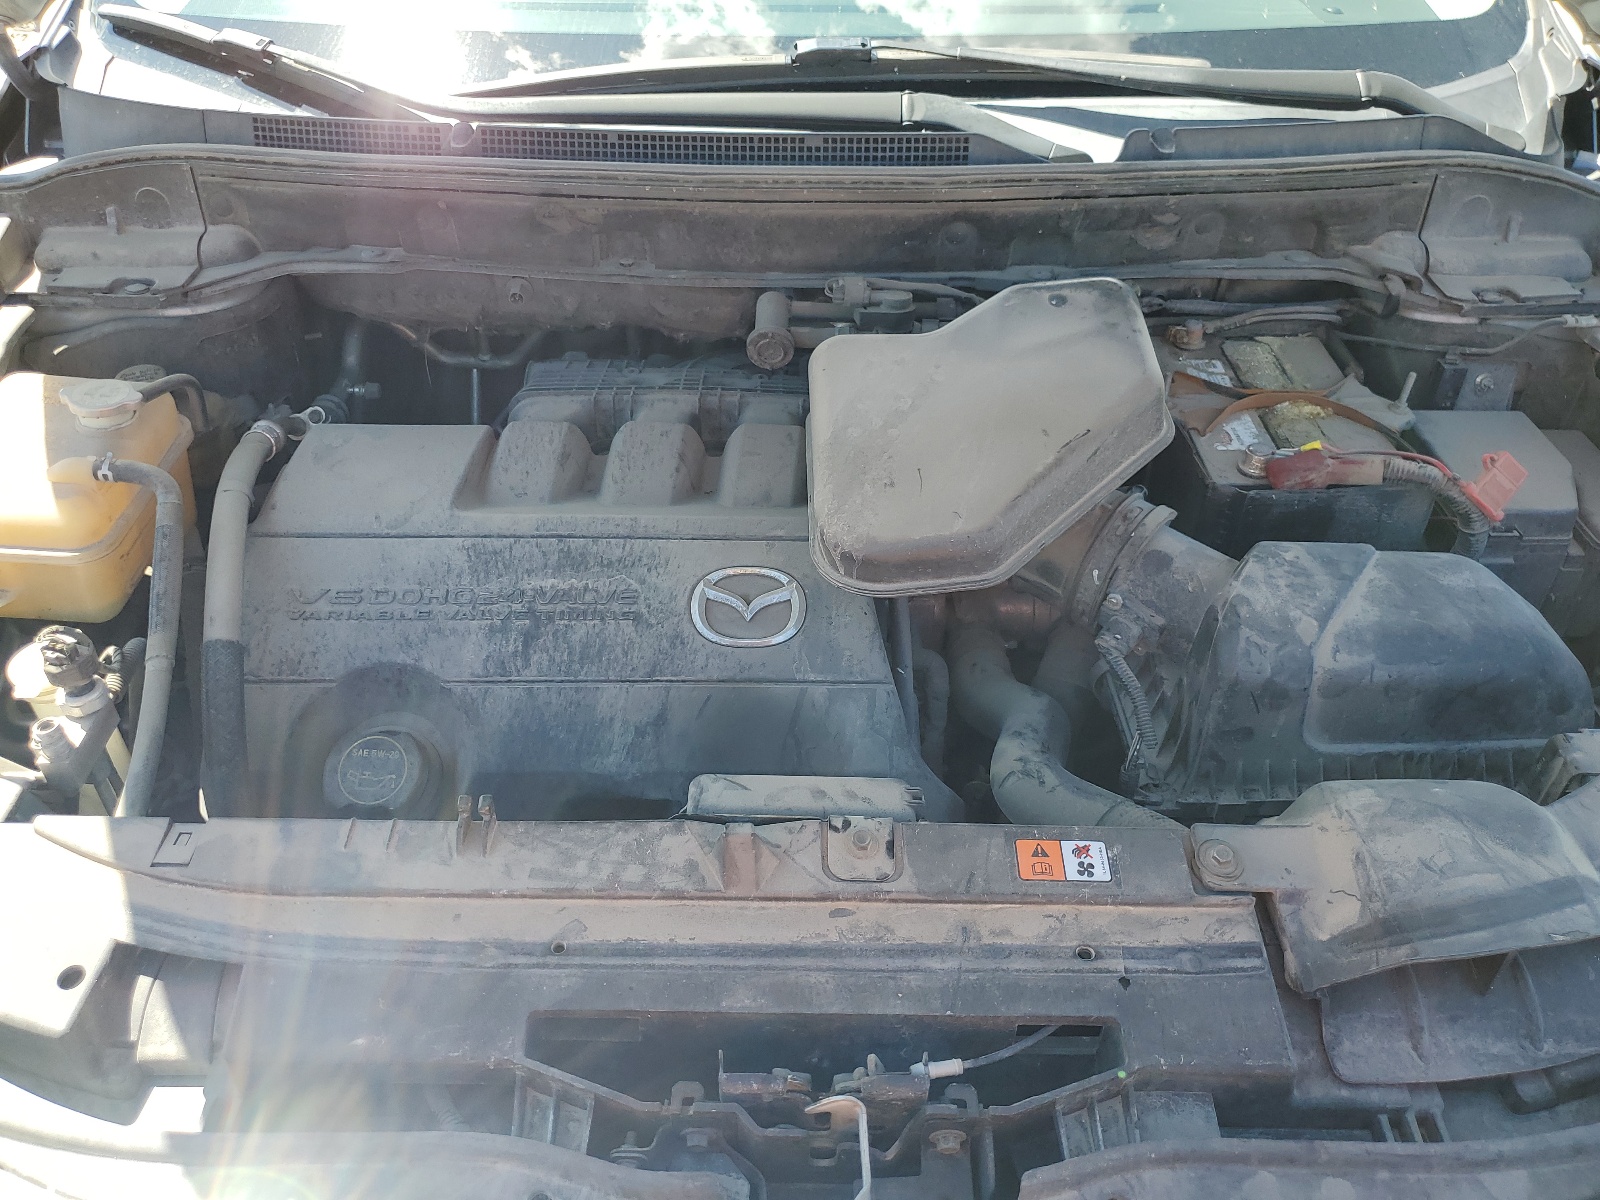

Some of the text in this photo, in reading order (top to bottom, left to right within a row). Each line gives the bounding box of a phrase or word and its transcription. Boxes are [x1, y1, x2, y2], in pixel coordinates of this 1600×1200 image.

[368, 587, 475, 605] DOHC
[288, 609, 636, 622] VARIABLE VALVE TIMING
[352, 748, 400, 760] SAE 5W-20
